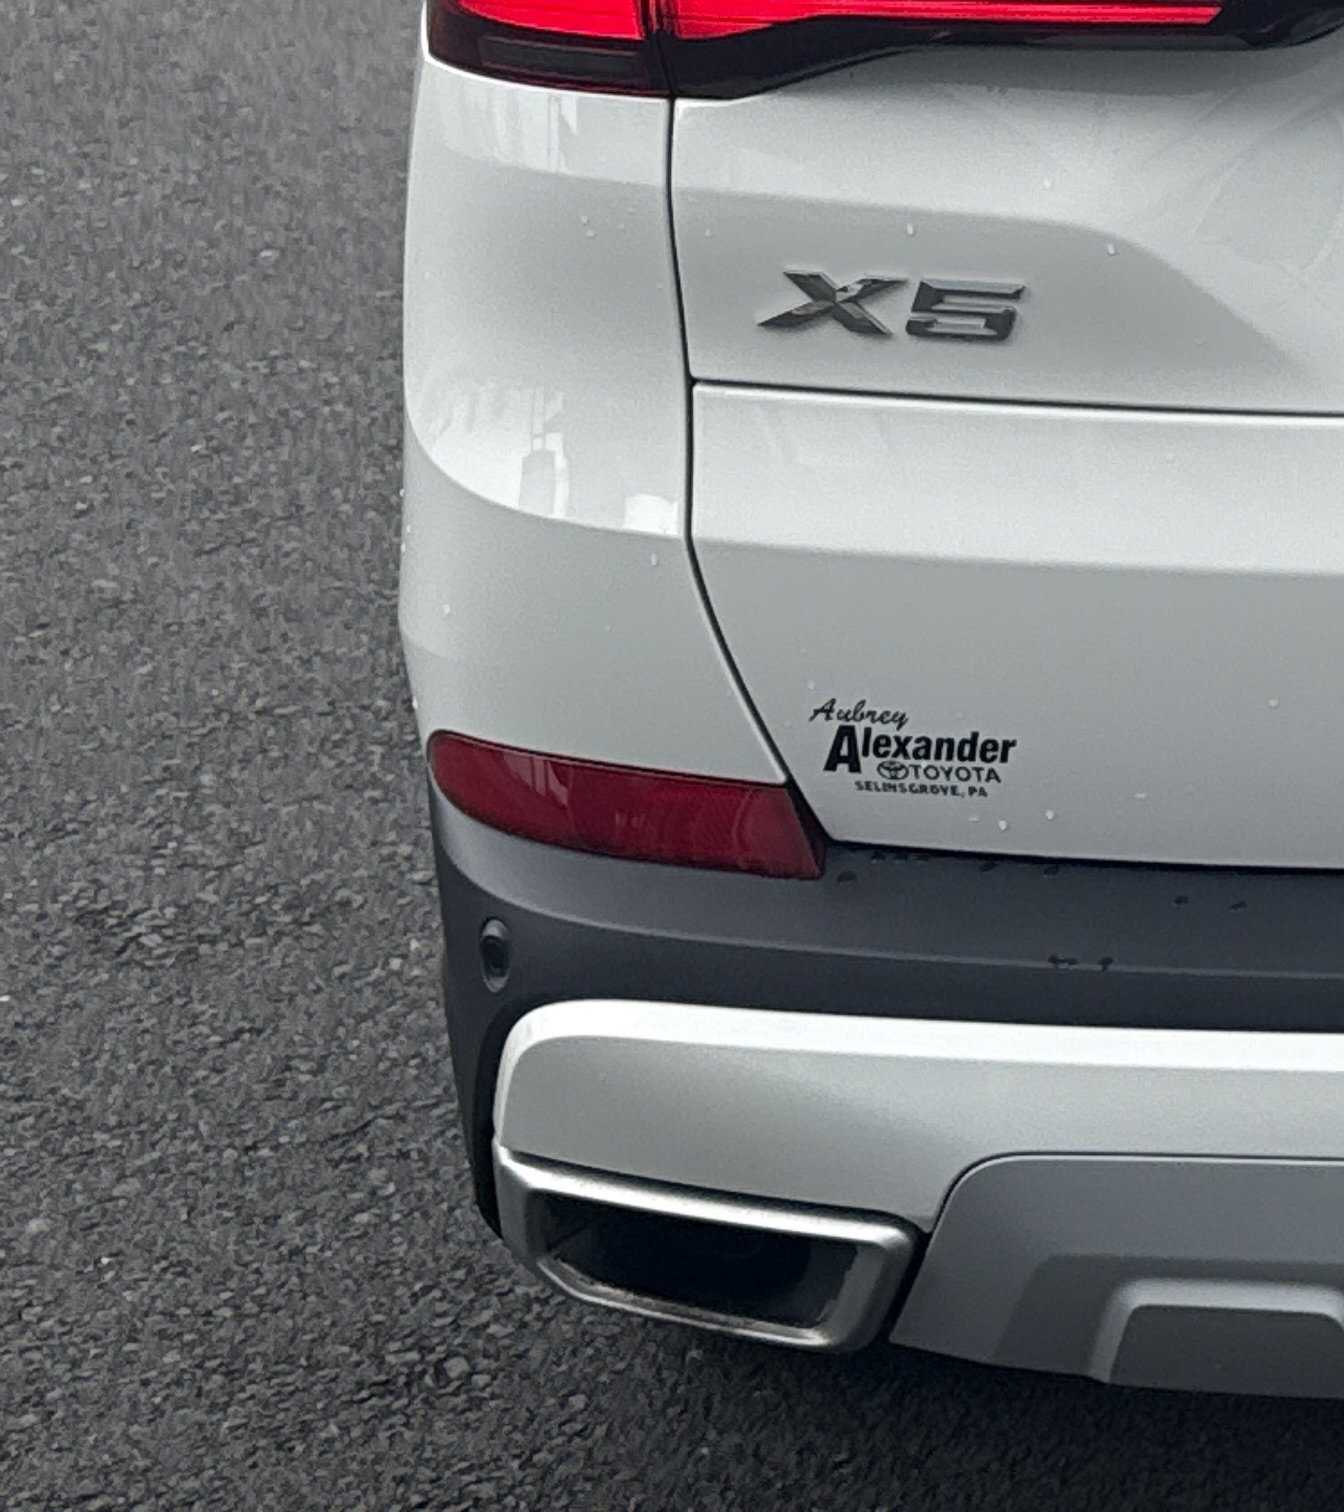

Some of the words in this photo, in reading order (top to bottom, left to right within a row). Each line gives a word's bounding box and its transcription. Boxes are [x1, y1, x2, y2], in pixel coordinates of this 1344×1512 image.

[756, 269, 1027, 340] X5
[808, 697, 909, 732] Aubrey
[822, 724, 1018, 774] Alexander
[908, 763, 1002, 784] TOYOTA
[968, 785, 989, 798] PA
